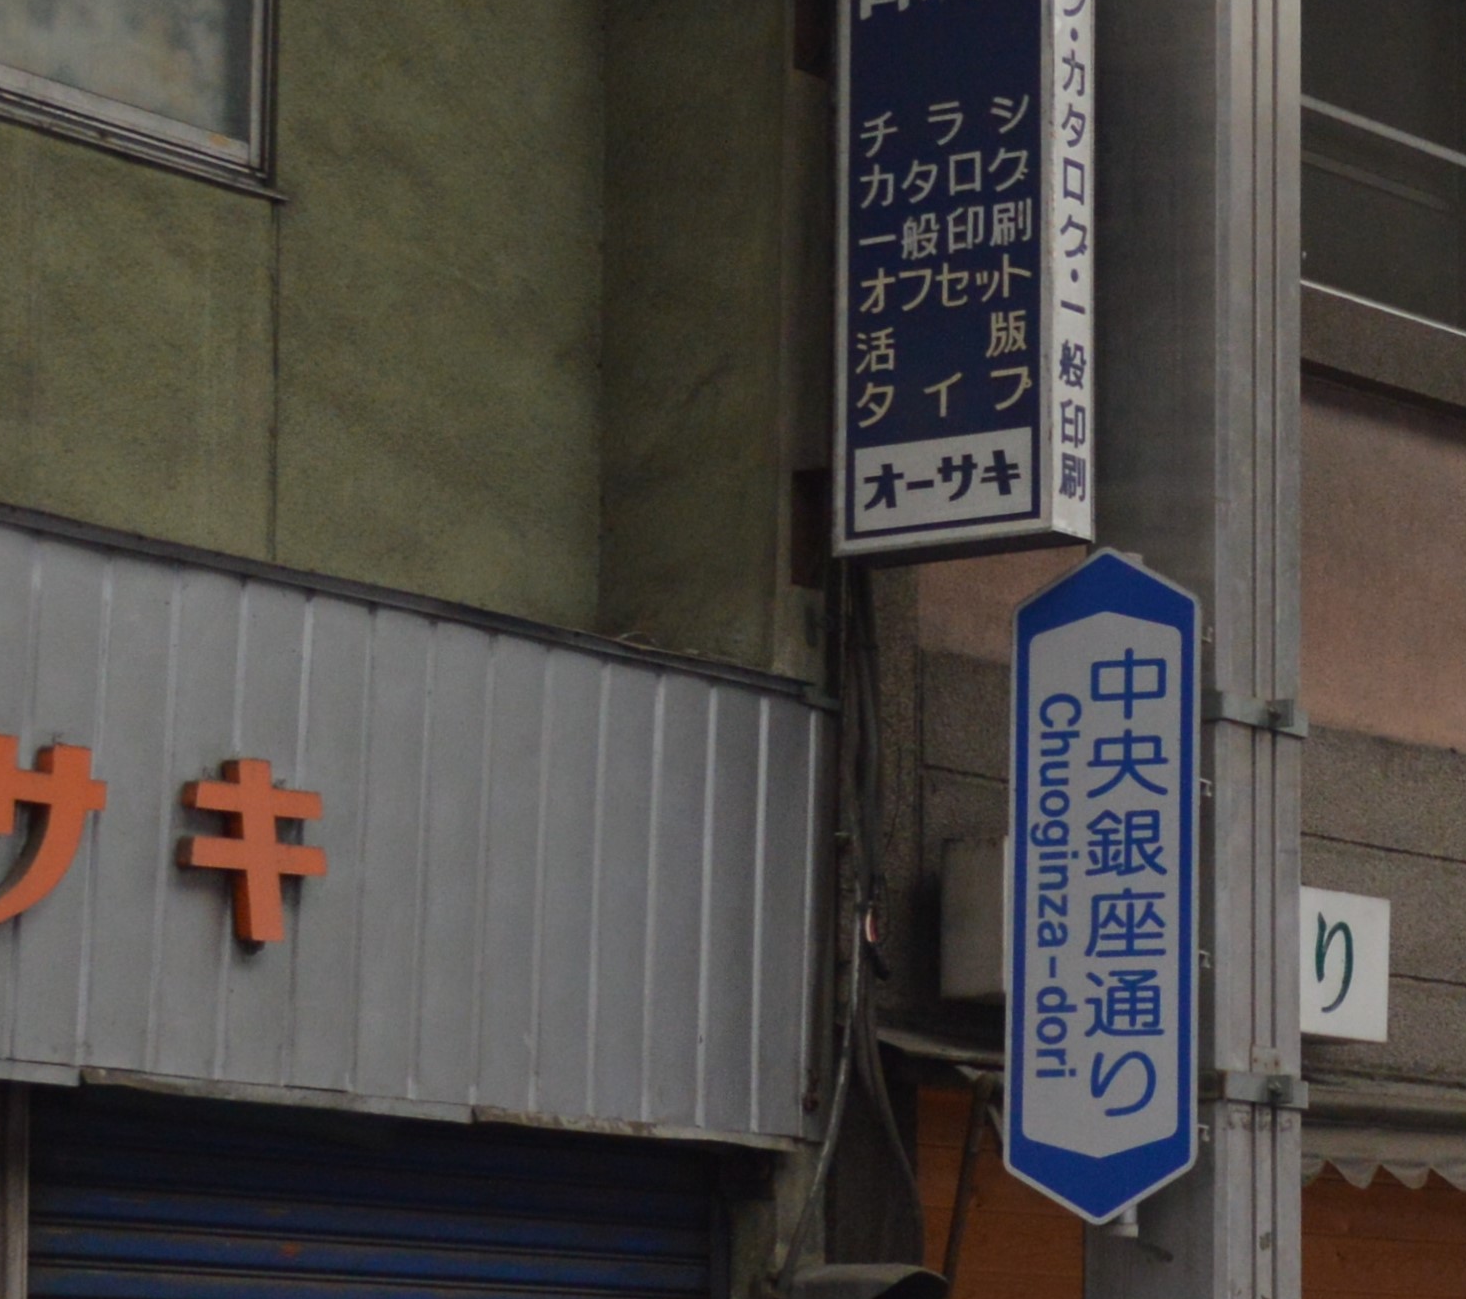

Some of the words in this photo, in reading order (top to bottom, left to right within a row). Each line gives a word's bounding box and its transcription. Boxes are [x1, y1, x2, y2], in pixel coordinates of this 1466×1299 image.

[859, 93, 1030, 160] チラシ
[858, 147, 1030, 210] カタログ
[857, 196, 1033, 261] 一般印刷
[857, 252, 1033, 316] オフセット
[855, 366, 1033, 431] タイプ
[862, 448, 1022, 512] オーサキ
[1030, 692, 1083, 1081] Chuoginza-dori
[1084, 648, 1169, 1118] 中央銀座通り
